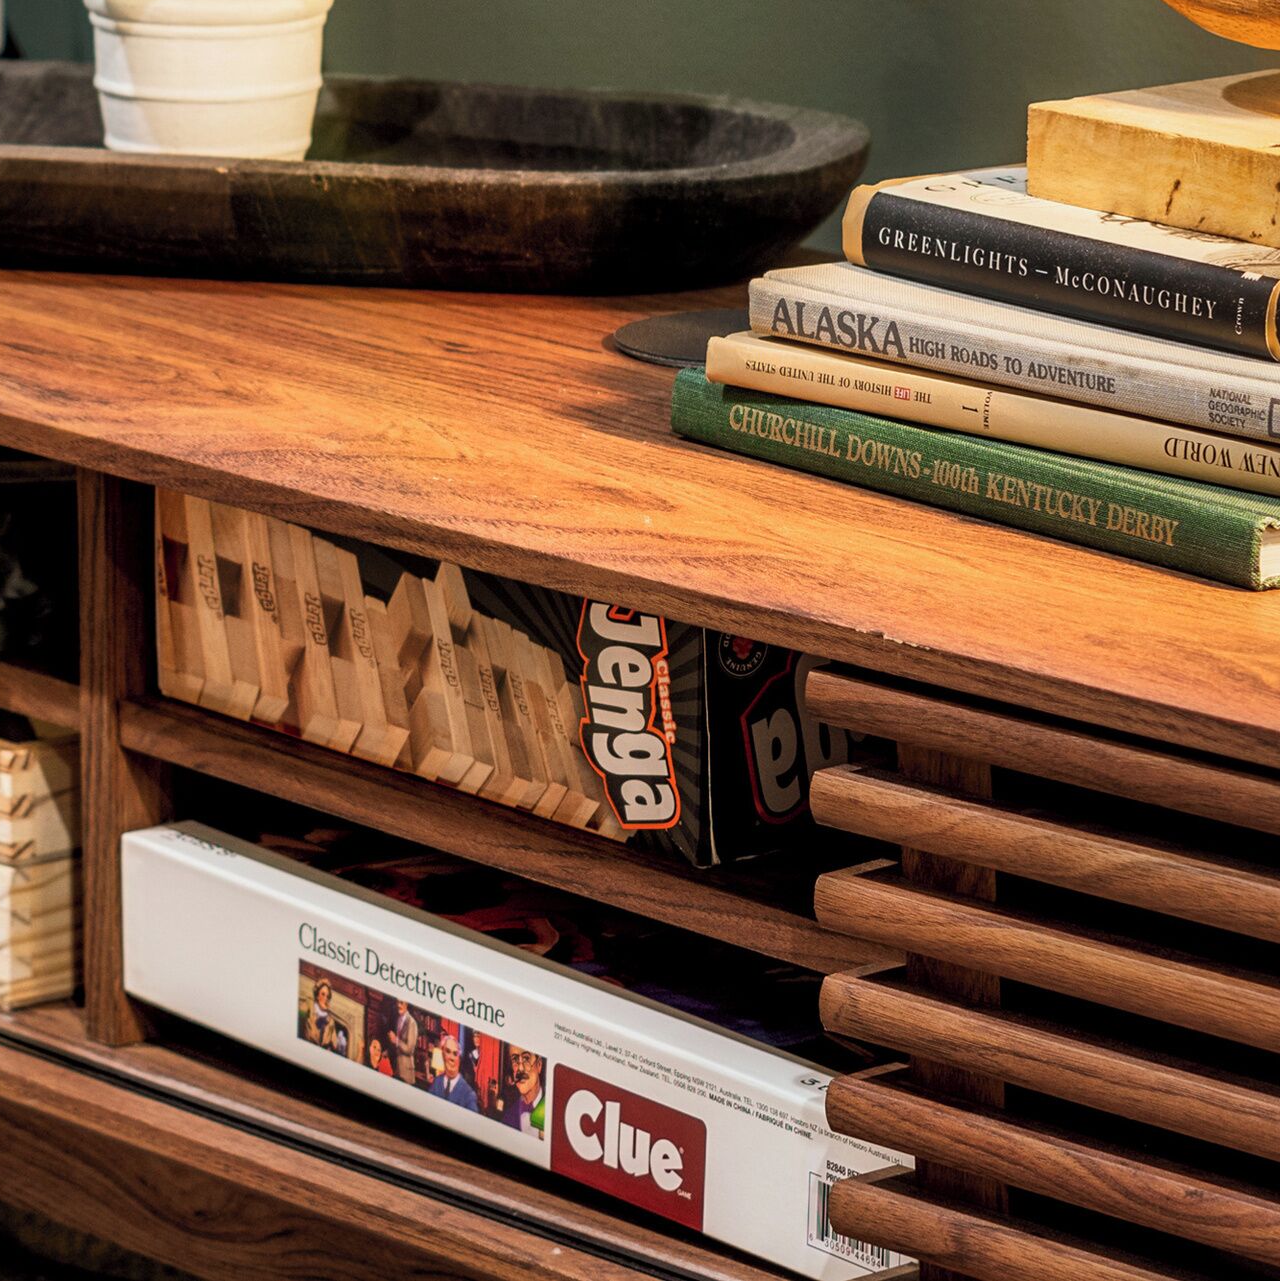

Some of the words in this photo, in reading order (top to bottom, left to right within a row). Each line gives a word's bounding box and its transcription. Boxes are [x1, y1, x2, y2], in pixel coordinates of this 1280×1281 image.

[877, 225, 1029, 277] GREENLIGHTS
[1054, 265, 1218, 320] McCONAUGHEY
[1234, 297, 1245, 335] Crown
[771, 297, 907, 359] ALASKA
[908, 336, 946, 360] HIGH
[950, 341, 998, 371] ROADS
[1003, 355, 1023, 376] TO
[1027, 363, 1117, 394] ADVENTURE
[745, 360, 776, 374] STATES
[779, 366, 814, 382] UNITED
[817, 372, 836, 386] THE
[839, 377, 851, 389] OF
[853, 379, 892, 397] HISTORY
[894, 387, 910, 400] LIFE
[1209, 388, 1251, 405] NATIONAL
[914, 391, 932, 404] THE
[983, 391, 993, 430] VOLUME
[1208, 400, 1266, 421] GEOGRAPHIC
[1208, 412, 1246, 428] SOCIETY
[1163, 436, 1234, 470] WORLD
[729, 404, 841, 458] CHURCHILL
[985, 471, 1102, 526] KENTUCKY
[1106, 502, 1180, 547] DERBY
[252, 561, 276, 612] Jenga
[304, 592, 327, 646] Jenga
[725, 650, 762, 672] GENUINE
[588, 601, 676, 822] Jenga
[297, 922, 361, 970] Classic
[364, 947, 447, 1004] Detective
[450, 982, 505, 1027] Game
[708, 1092, 726, 1106] MADE
[725, 1099, 733, 1108] IN
[733, 1102, 751, 1115] CHINA
[784, 1122, 793, 1132] EN
[564, 1089, 684, 1192] Clue
[825, 1240, 852, 1256] 30509
